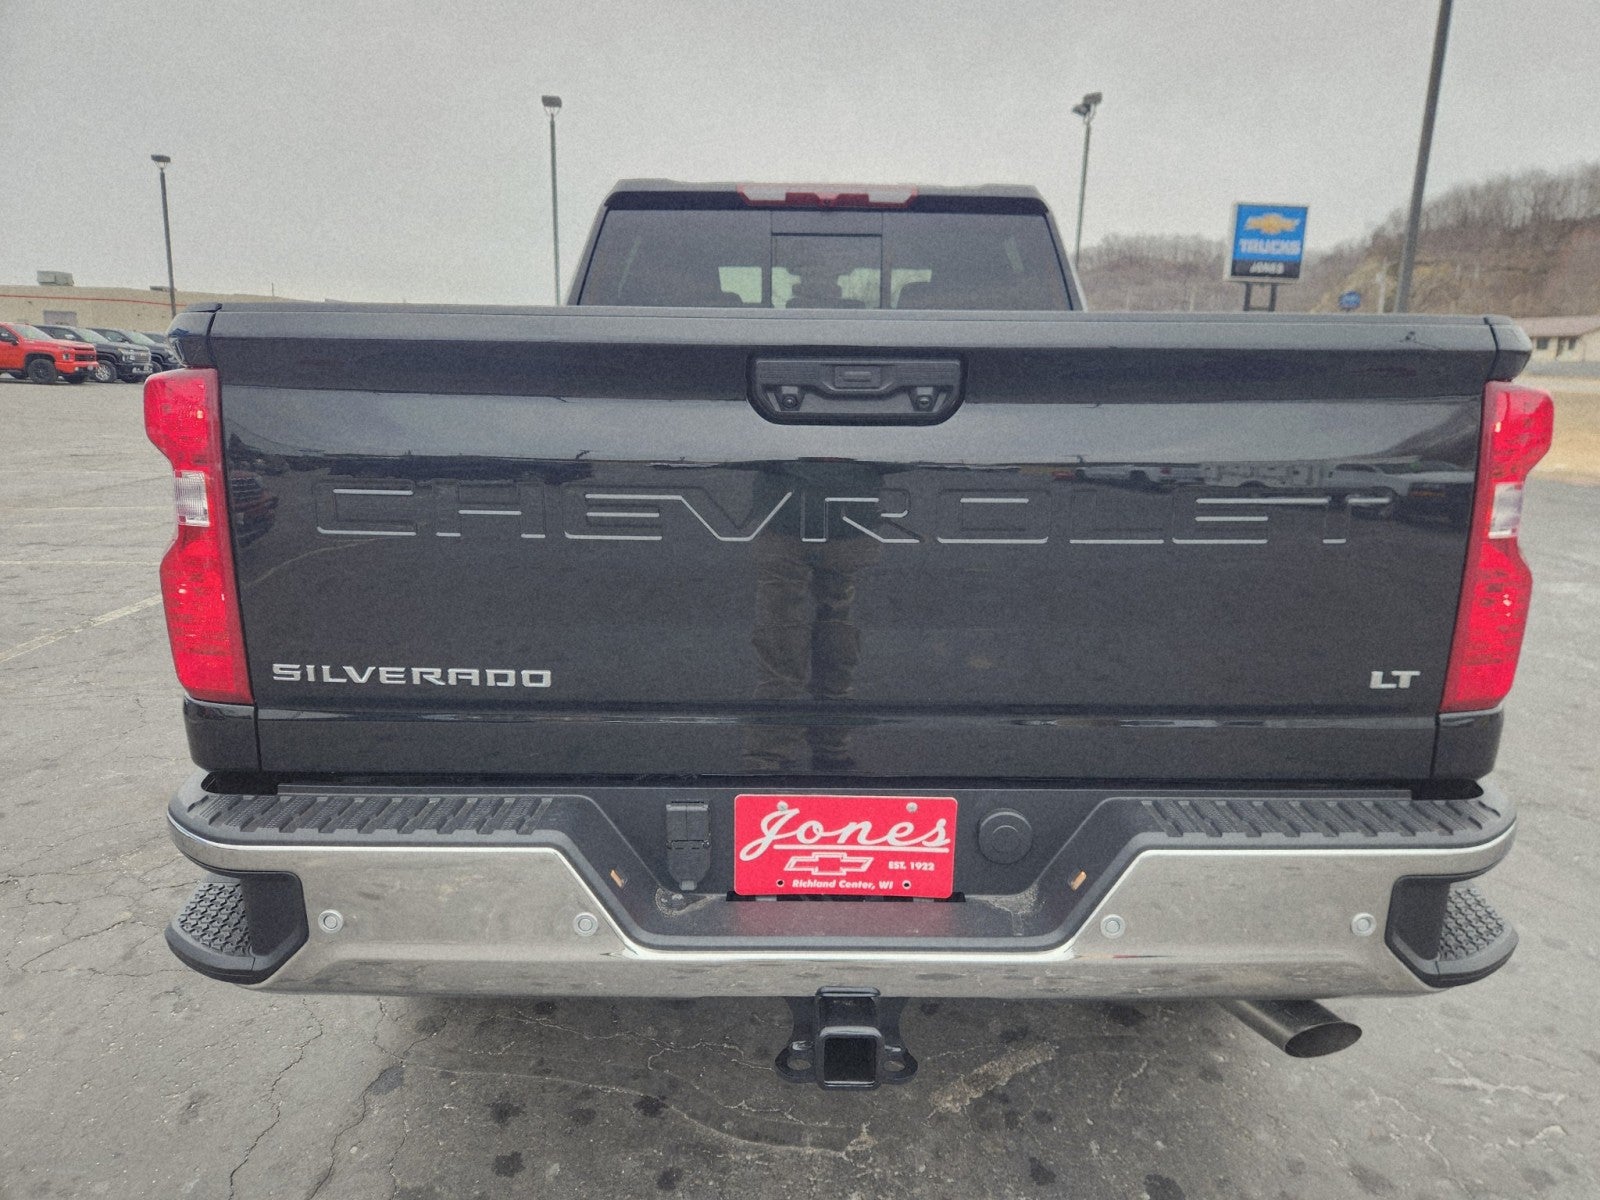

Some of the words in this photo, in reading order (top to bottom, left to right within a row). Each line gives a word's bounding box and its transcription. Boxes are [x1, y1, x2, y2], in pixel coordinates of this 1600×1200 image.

[1239, 238, 1301, 255] TRUCKS
[312, 479, 1393, 544] CHEVROLET
[272, 663, 552, 688] SILVERADO
[1369, 670, 1421, 690] LT
[739, 807, 952, 862] Jones
[888, 860, 907, 870] EST.
[910, 861, 935, 871] 1922
[792, 879, 837, 888] Richland
[838, 879, 876, 891] Center,
[878, 880, 894, 890] WI
